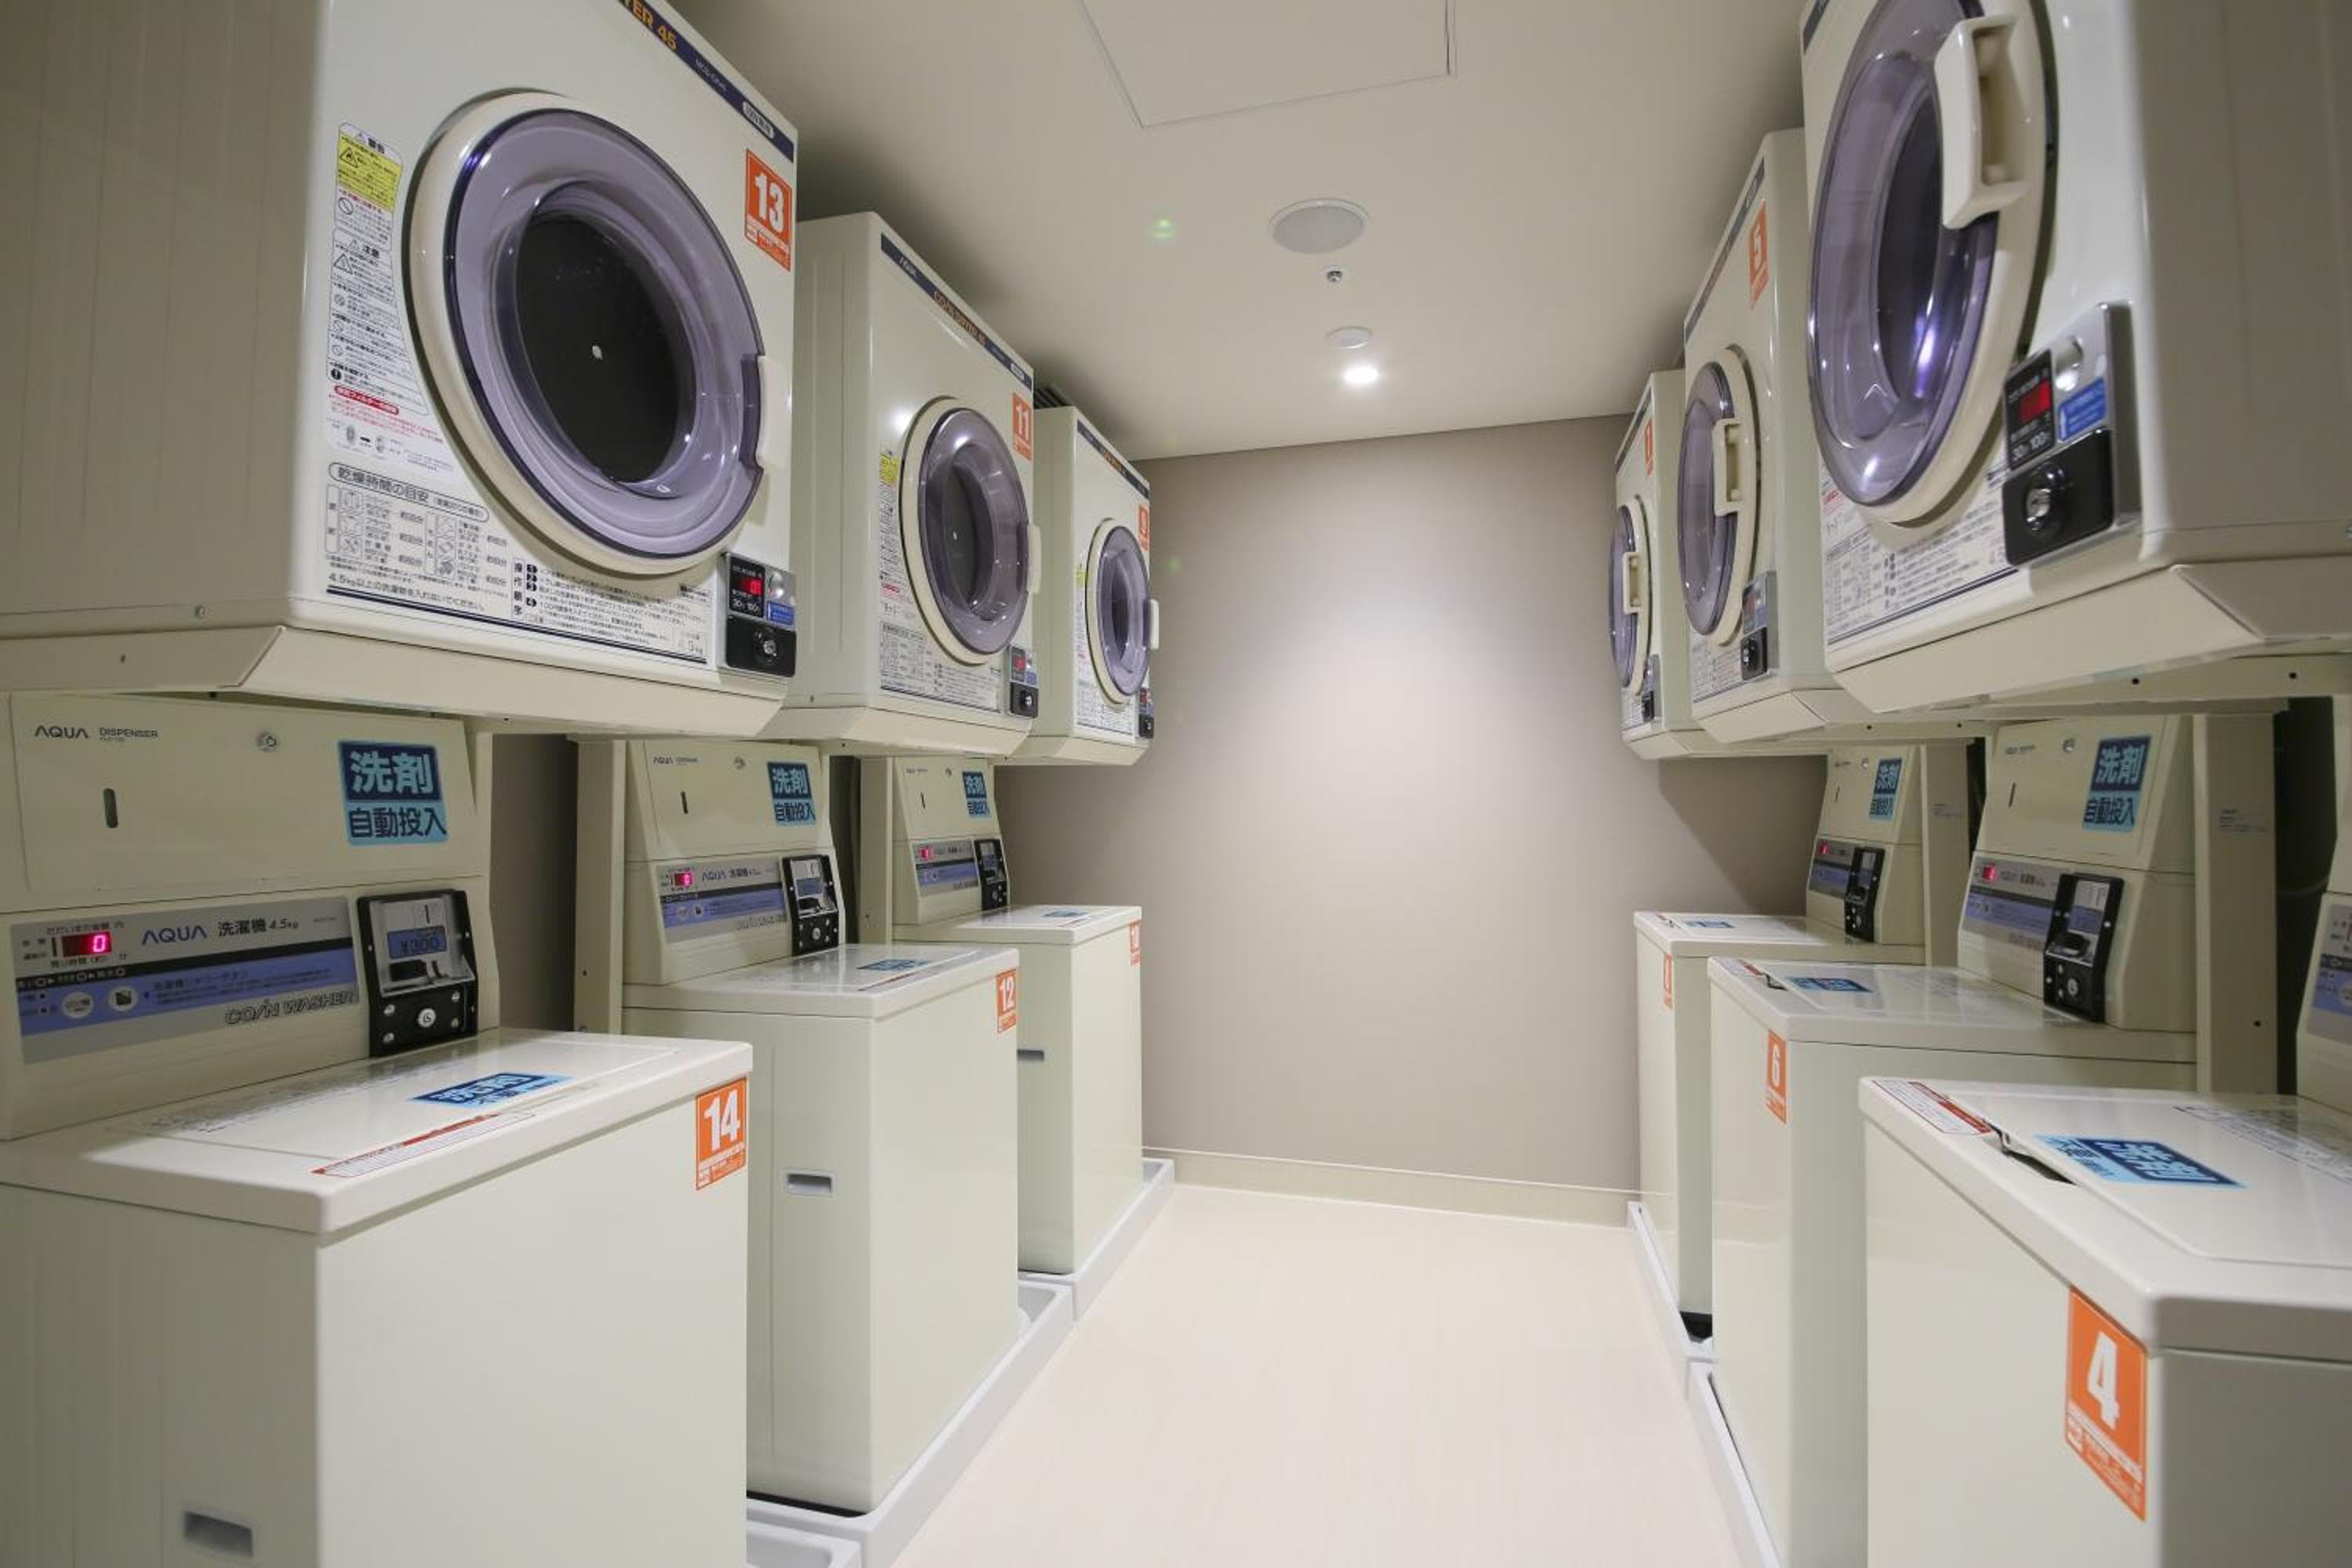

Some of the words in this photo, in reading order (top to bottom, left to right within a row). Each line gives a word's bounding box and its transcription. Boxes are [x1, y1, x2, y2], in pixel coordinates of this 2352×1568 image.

[658, 24, 677, 50] 45
[755, 173, 784, 232] 13
[1016, 402, 1029, 441] 11
[34, 724, 89, 739] AQUA
[99, 727, 158, 739] DISPENSER
[350, 750, 434, 794] 洗剤
[2095, 743, 2146, 785] 洗剤
[772, 768, 808, 794] 洗剤
[349, 807, 447, 838] 自動投入
[775, 801, 816, 822] 自動投入
[2084, 796, 2135, 826] 自動投入
[93, 934, 107, 953] 0
[142, 925, 207, 946] AQUA
[218, 919, 267, 937] 洗濯機
[284, 990, 354, 1014] WASHER
[1000, 976, 1014, 1011] 12
[1773, 1044, 1780, 1087] 6
[704, 1089, 741, 1151] 14
[2086, 1330, 2120, 1429] 4
